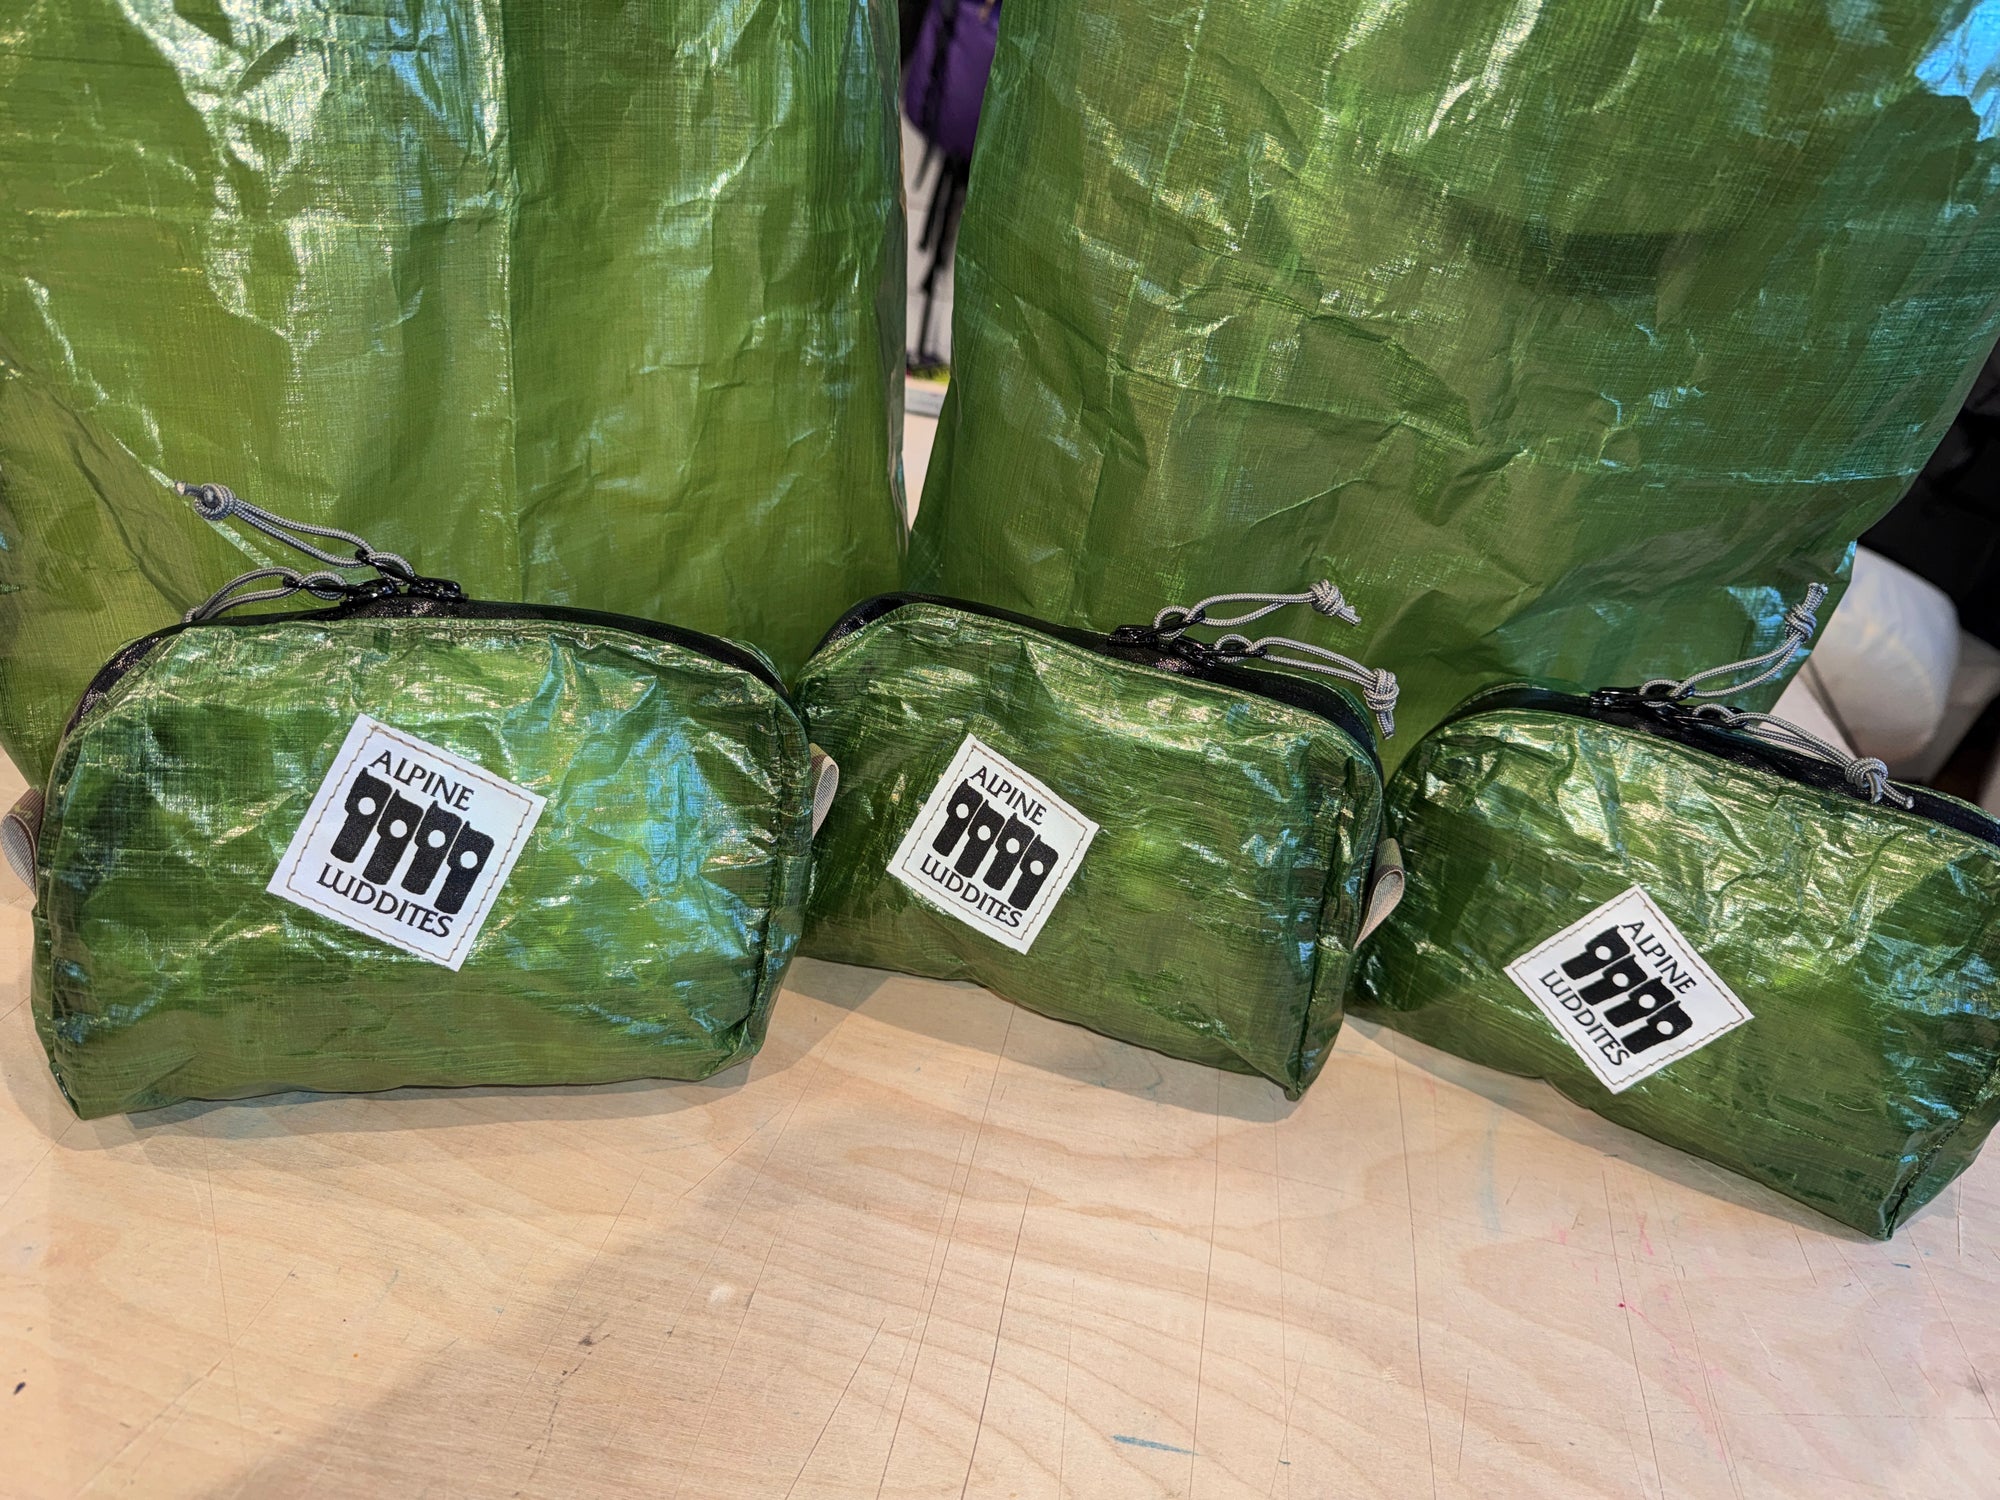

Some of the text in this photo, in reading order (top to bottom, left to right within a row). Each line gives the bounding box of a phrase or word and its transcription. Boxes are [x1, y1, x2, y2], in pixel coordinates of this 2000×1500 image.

[369, 750, 474, 811] ALPINE
[970, 765, 1047, 826] ALPINE
[316, 863, 453, 938] LUDDITES
[920, 854, 1023, 928] LUDDITES
[1622, 920, 1697, 994] ALPINE
[1538, 969, 1630, 1066] LUDDITES
